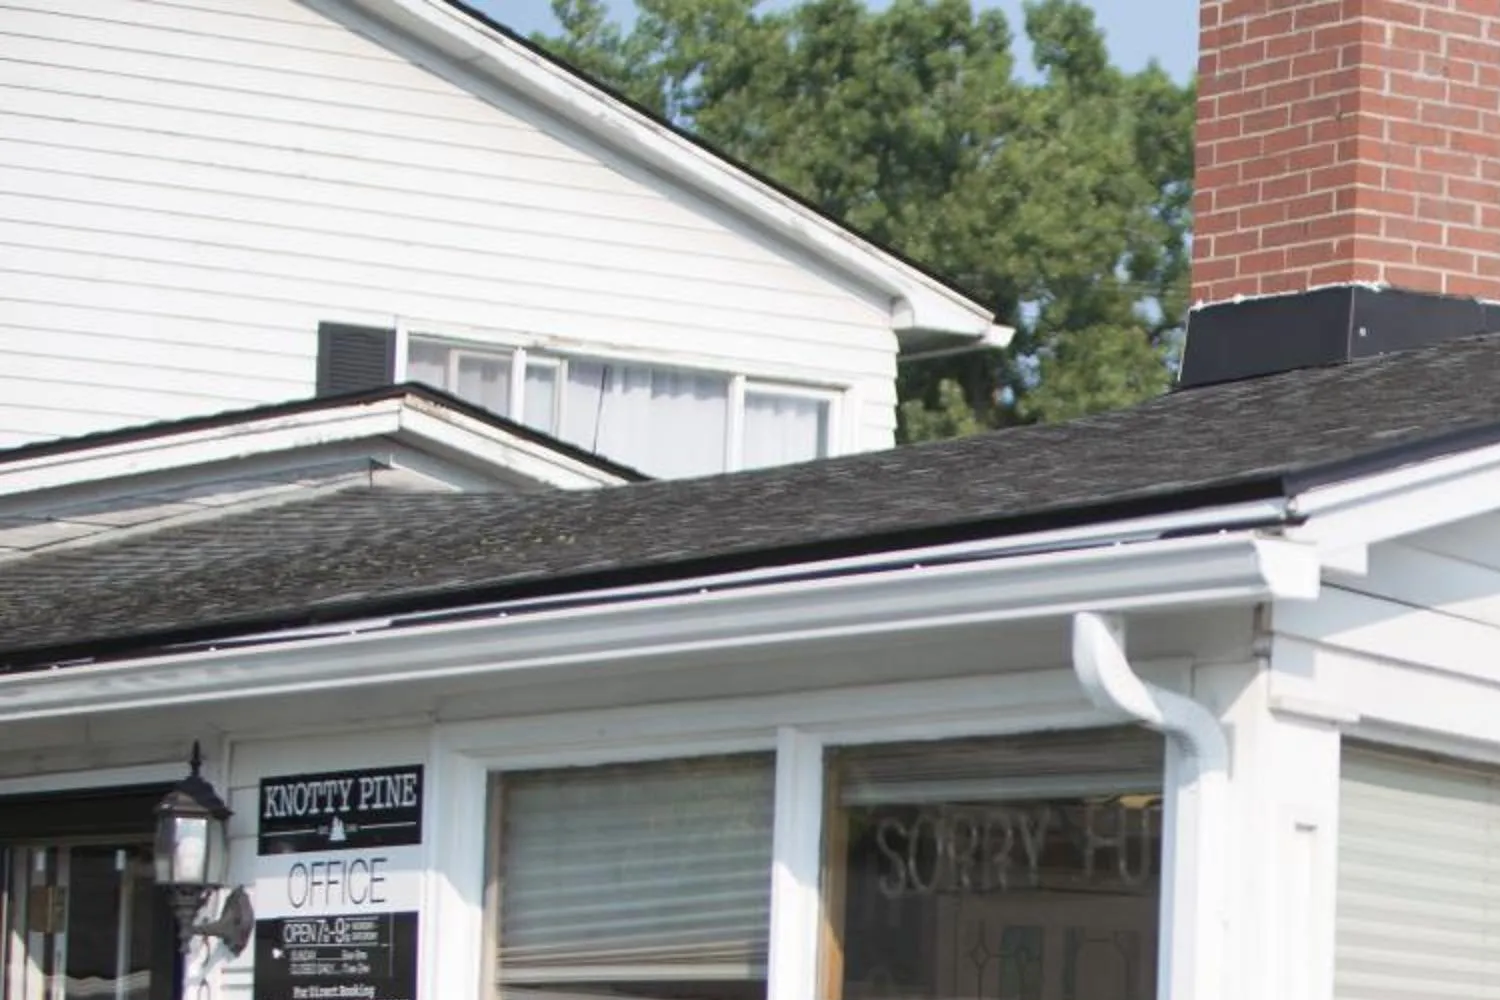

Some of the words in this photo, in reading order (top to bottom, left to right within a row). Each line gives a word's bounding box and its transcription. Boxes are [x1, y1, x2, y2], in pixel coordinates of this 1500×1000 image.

[264, 779, 353, 818] KNOTTY
[358, 773, 418, 808] PINE
[875, 805, 1051, 899] SORRY
[287, 857, 389, 910] OFFICE
[282, 922, 317, 943] OPEN
